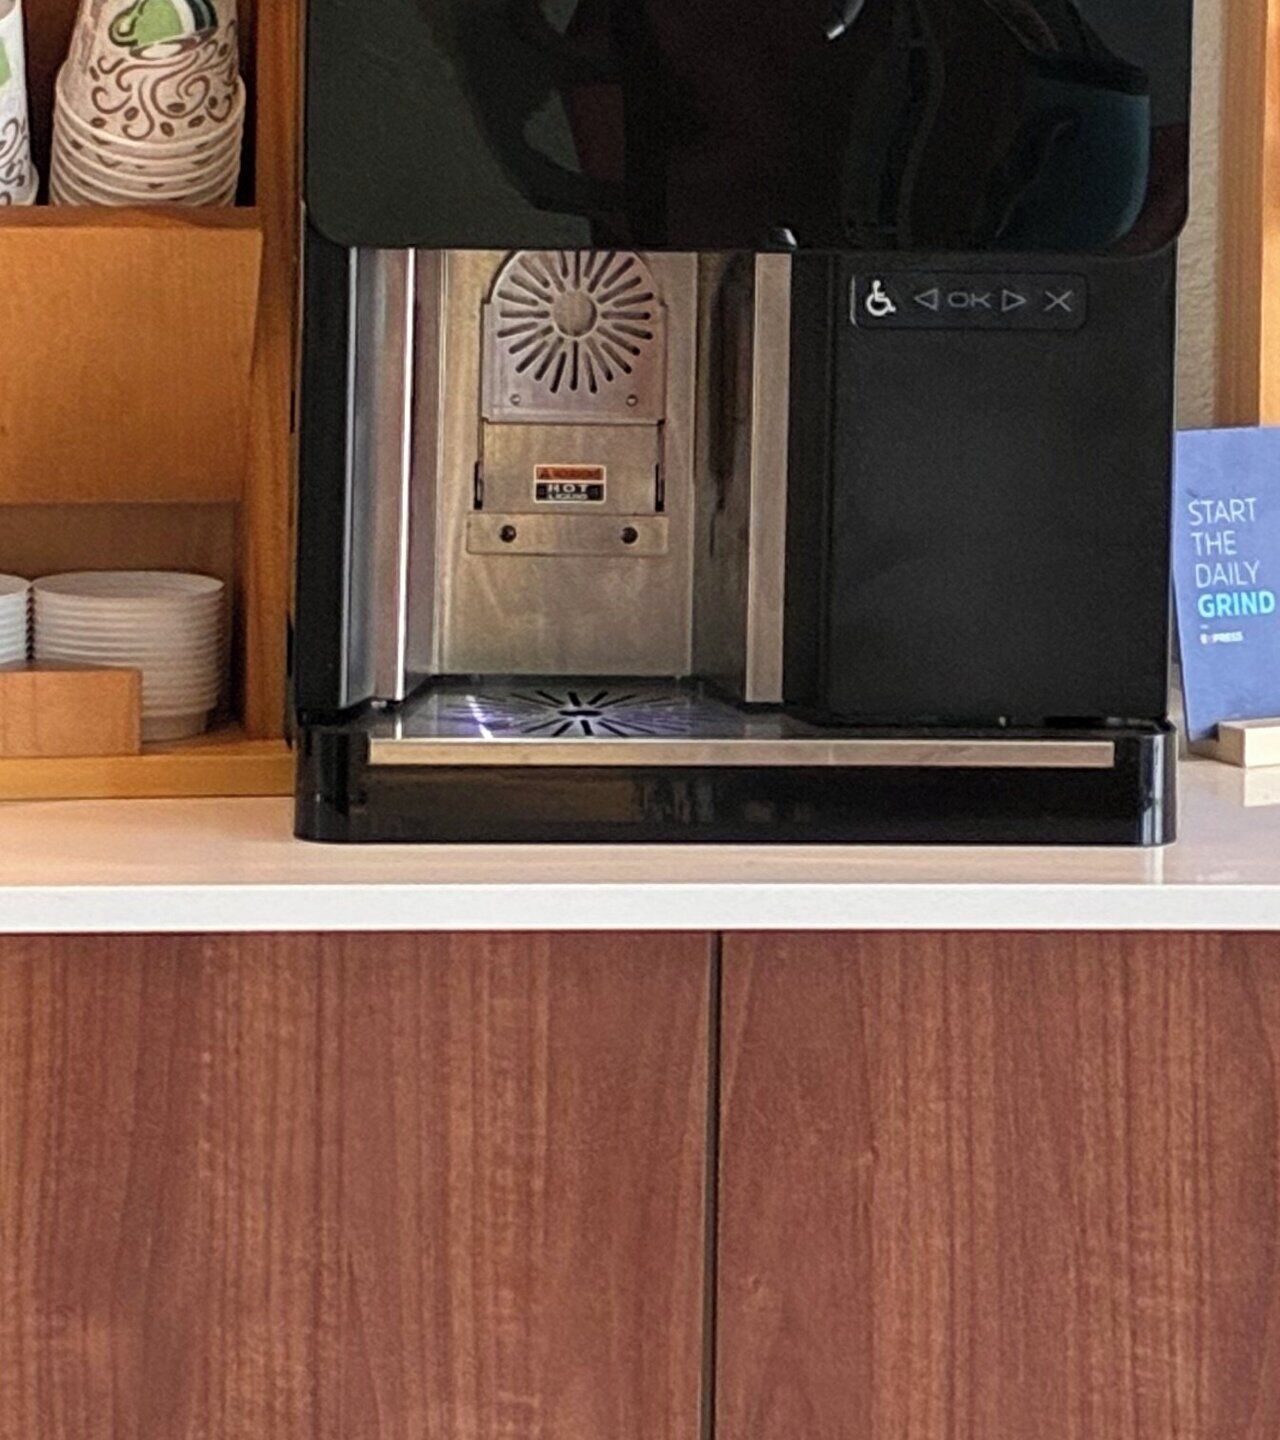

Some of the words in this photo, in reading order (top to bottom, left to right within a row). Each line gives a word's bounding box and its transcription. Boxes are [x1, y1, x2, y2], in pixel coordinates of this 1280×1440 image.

[947, 292, 991, 308] OK
[548, 484, 588, 493] HOT
[1189, 497, 1257, 526] START
[1191, 530, 1237, 556] THE
[1195, 560, 1260, 588] DAILY
[1197, 590, 1275, 618] GRIND
